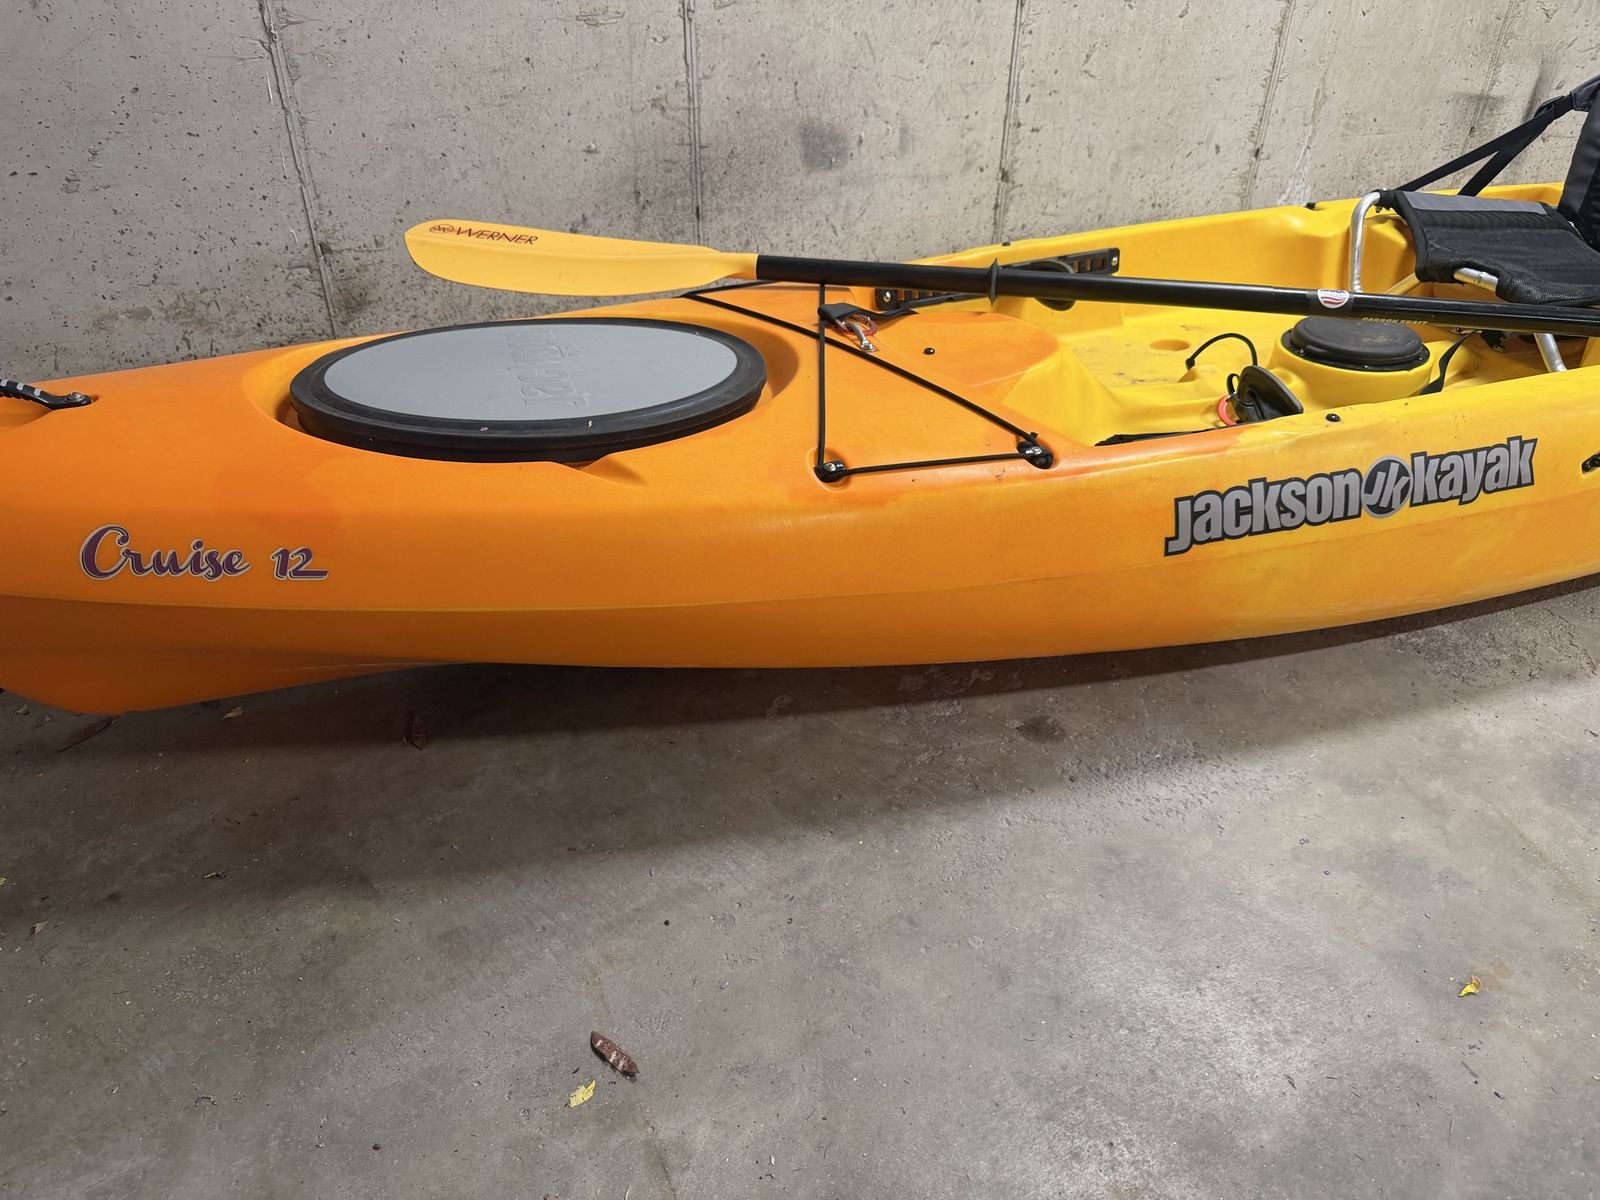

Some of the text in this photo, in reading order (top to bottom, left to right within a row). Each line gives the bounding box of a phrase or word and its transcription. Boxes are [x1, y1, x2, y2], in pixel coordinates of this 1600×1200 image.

[456, 227, 538, 245] WERNER
[1408, 436, 1538, 506] kayak
[80, 524, 328, 581] Cruise 12
